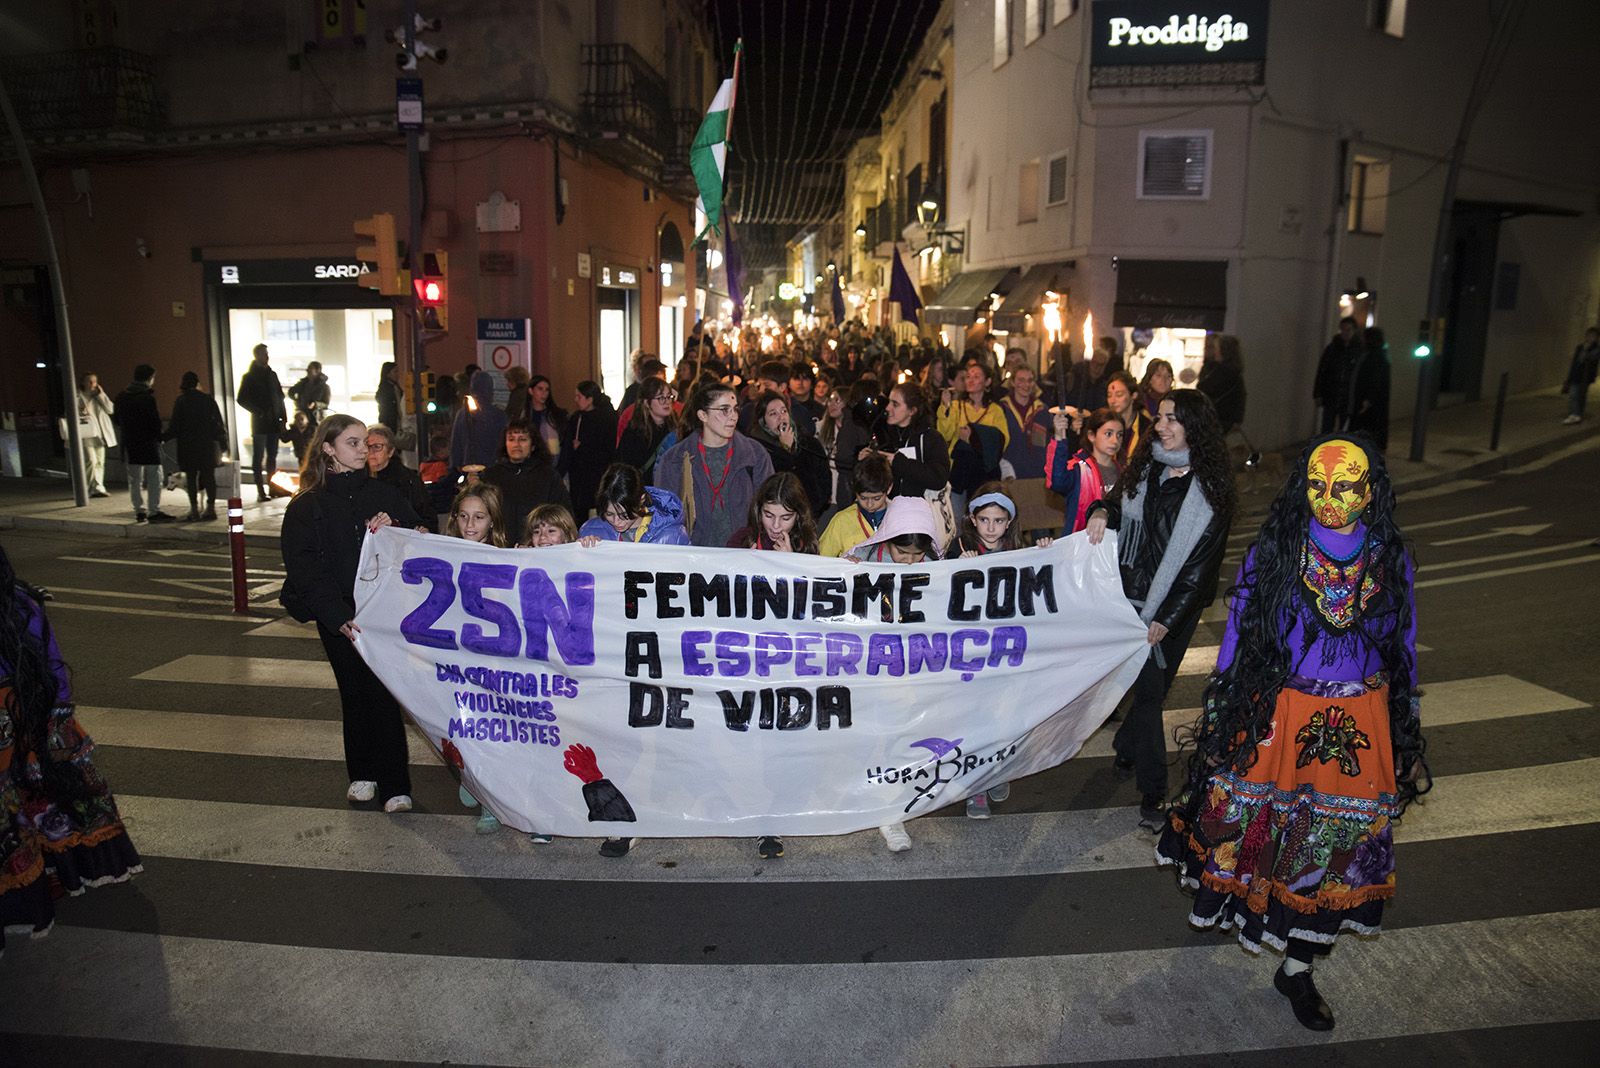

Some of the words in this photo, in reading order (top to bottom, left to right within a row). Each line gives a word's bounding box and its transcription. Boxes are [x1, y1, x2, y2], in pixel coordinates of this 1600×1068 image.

[1108, 14, 1249, 52] Proddigia
[400, 557, 595, 666] 25N
[624, 571, 930, 623] FEMINISME
[947, 564, 1058, 621] COM
[625, 631, 662, 679] A
[681, 626, 1028, 682] ESPERANÇA
[464, 667, 538, 698] CONTRA
[541, 673, 579, 699] LES
[454, 691, 557, 722] VIOLENCIES
[628, 681, 694, 729] DE
[716, 685, 852, 731] VIDA
[448, 717, 561, 747] MASCLISTES
[867, 766, 929, 784] HORA
